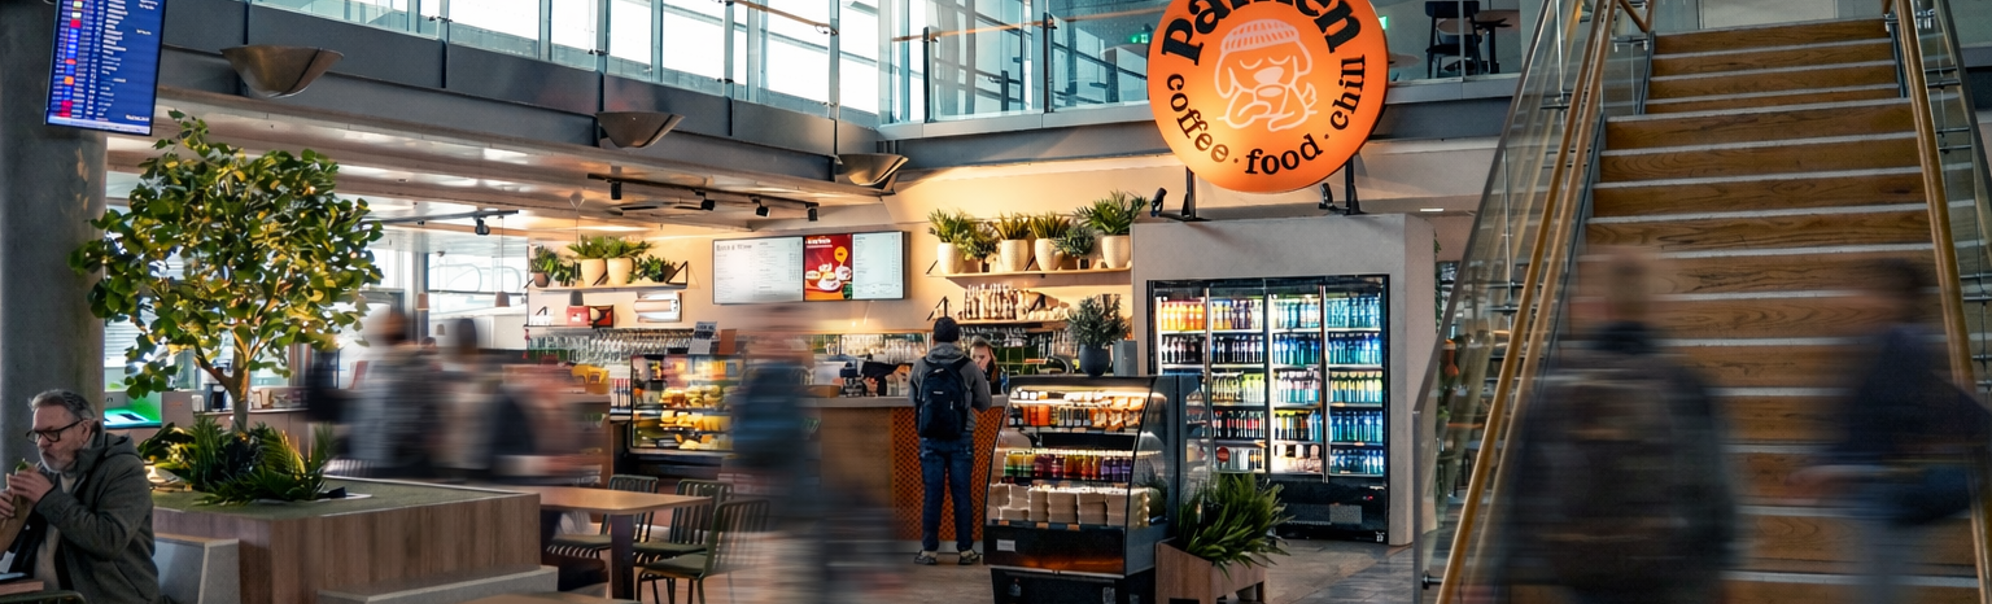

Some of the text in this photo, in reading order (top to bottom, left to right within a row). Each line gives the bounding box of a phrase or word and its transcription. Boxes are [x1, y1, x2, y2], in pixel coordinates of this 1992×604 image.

[1167, 54, 1366, 175] coffee food chill
